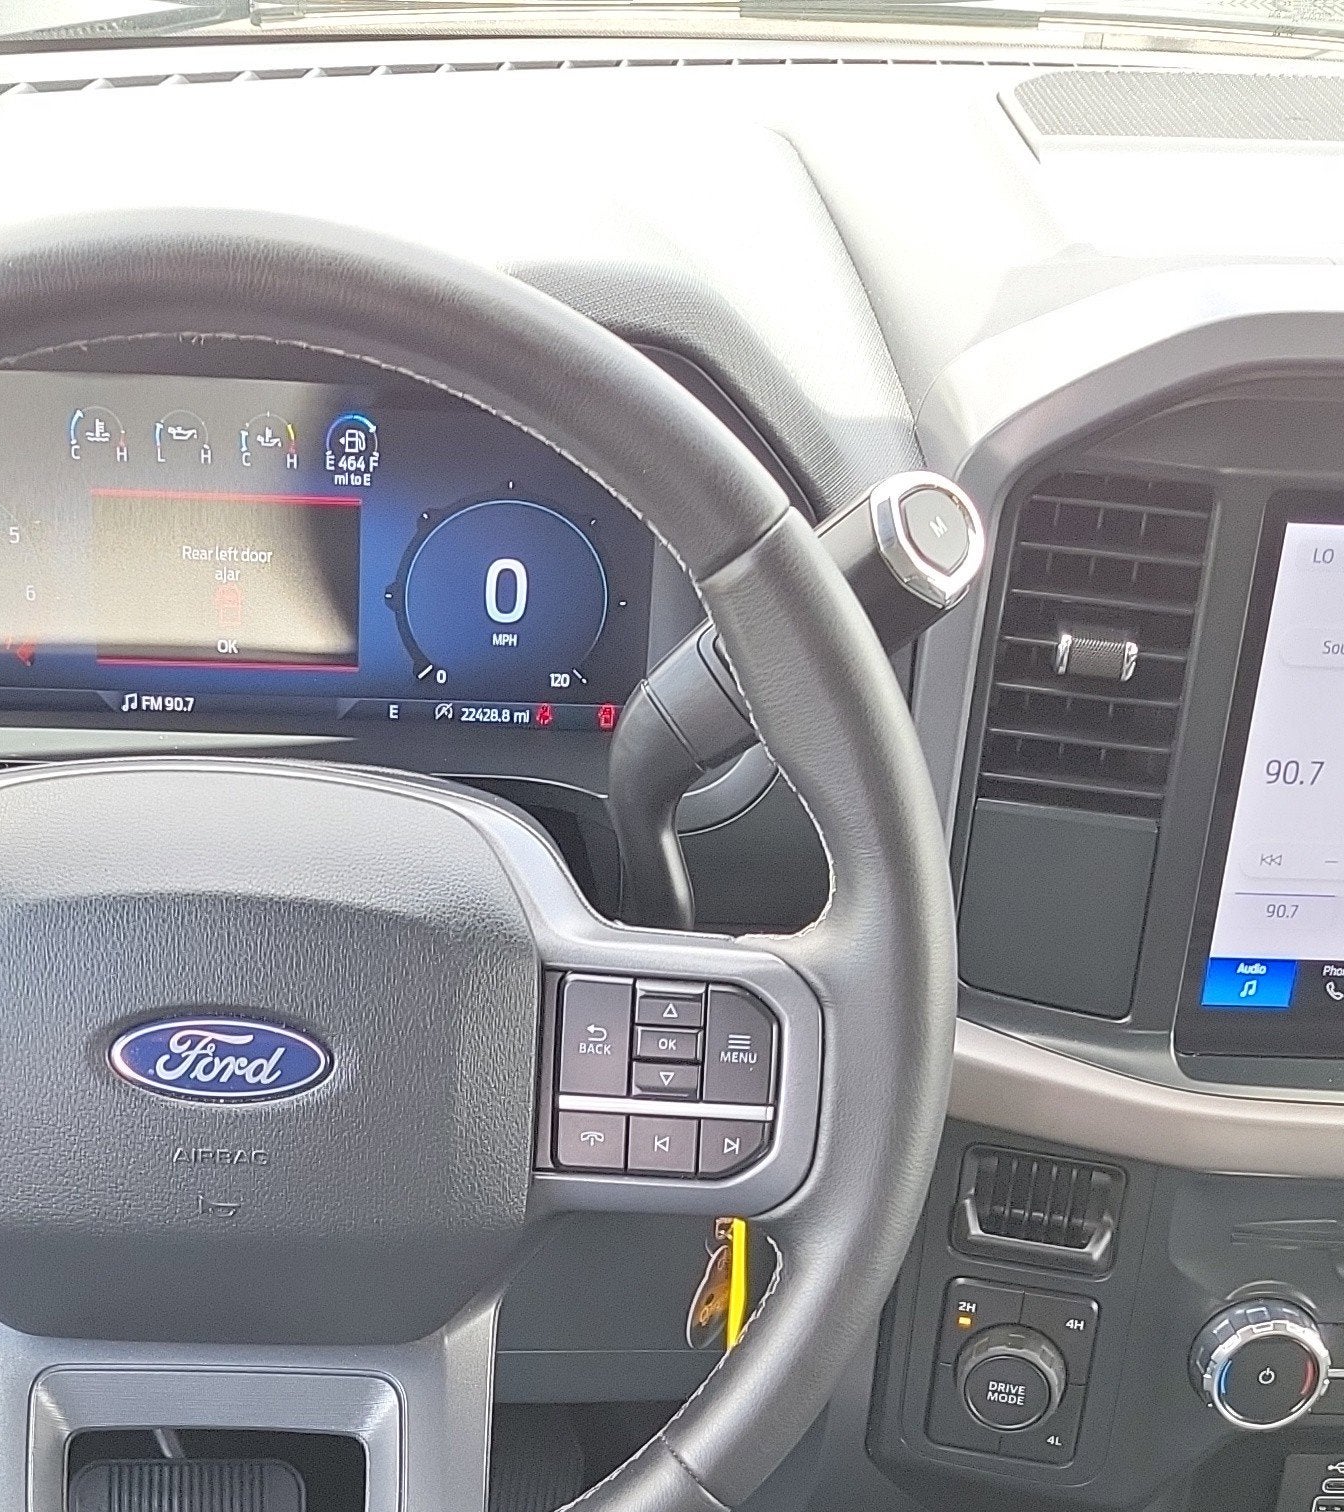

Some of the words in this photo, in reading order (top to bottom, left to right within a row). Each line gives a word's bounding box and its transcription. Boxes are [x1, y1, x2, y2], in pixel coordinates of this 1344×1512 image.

[71, 445, 81, 459] C
[117, 447, 128, 462] H
[157, 448, 165, 462] L
[201, 450, 211, 464] H
[242, 453, 251, 466] C
[287, 455, 297, 469] H
[325, 455, 335, 470] E
[338, 456, 366, 471] 464
[370, 458, 378, 472] F
[351, 474, 362, 485] to
[363, 474, 371, 486] E
[929, 516, 948, 538] M
[9, 527, 20, 543] 5
[182, 546, 213, 561] Rear
[216, 547, 238, 562] left
[241, 548, 273, 563] door
[1312, 547, 1335, 566] LO
[214, 567, 240, 584] ajar
[26, 585, 36, 601] 6
[485, 558, 528, 624] 0
[217, 640, 238, 654] OK
[492, 634, 518, 647] MPH
[436, 670, 447, 684] 0
[550, 673, 570, 687] 120
[142, 697, 162, 711] FM
[164, 697, 194, 712] 90.7
[389, 705, 399, 719] E
[460, 707, 510, 723] 22428.8
[1265, 759, 1325, 786] 90.7
[1266, 904, 1298, 920] 90.7
[1237, 963, 1266, 976] Audio
[579, 1043, 611, 1055] BACK
[658, 1038, 676, 1050] OK
[156, 1029, 285, 1084] Ford
[720, 1051, 757, 1064] MENU
[172, 1148, 269, 1165] AIRBAG
[958, 1301, 976, 1313] 2H
[1066, 1319, 1084, 1331] 4H
[988, 1381, 1026, 1395] DRIVE
[987, 1393, 1025, 1406] MODE
[1047, 1436, 1062, 1446] 4L
